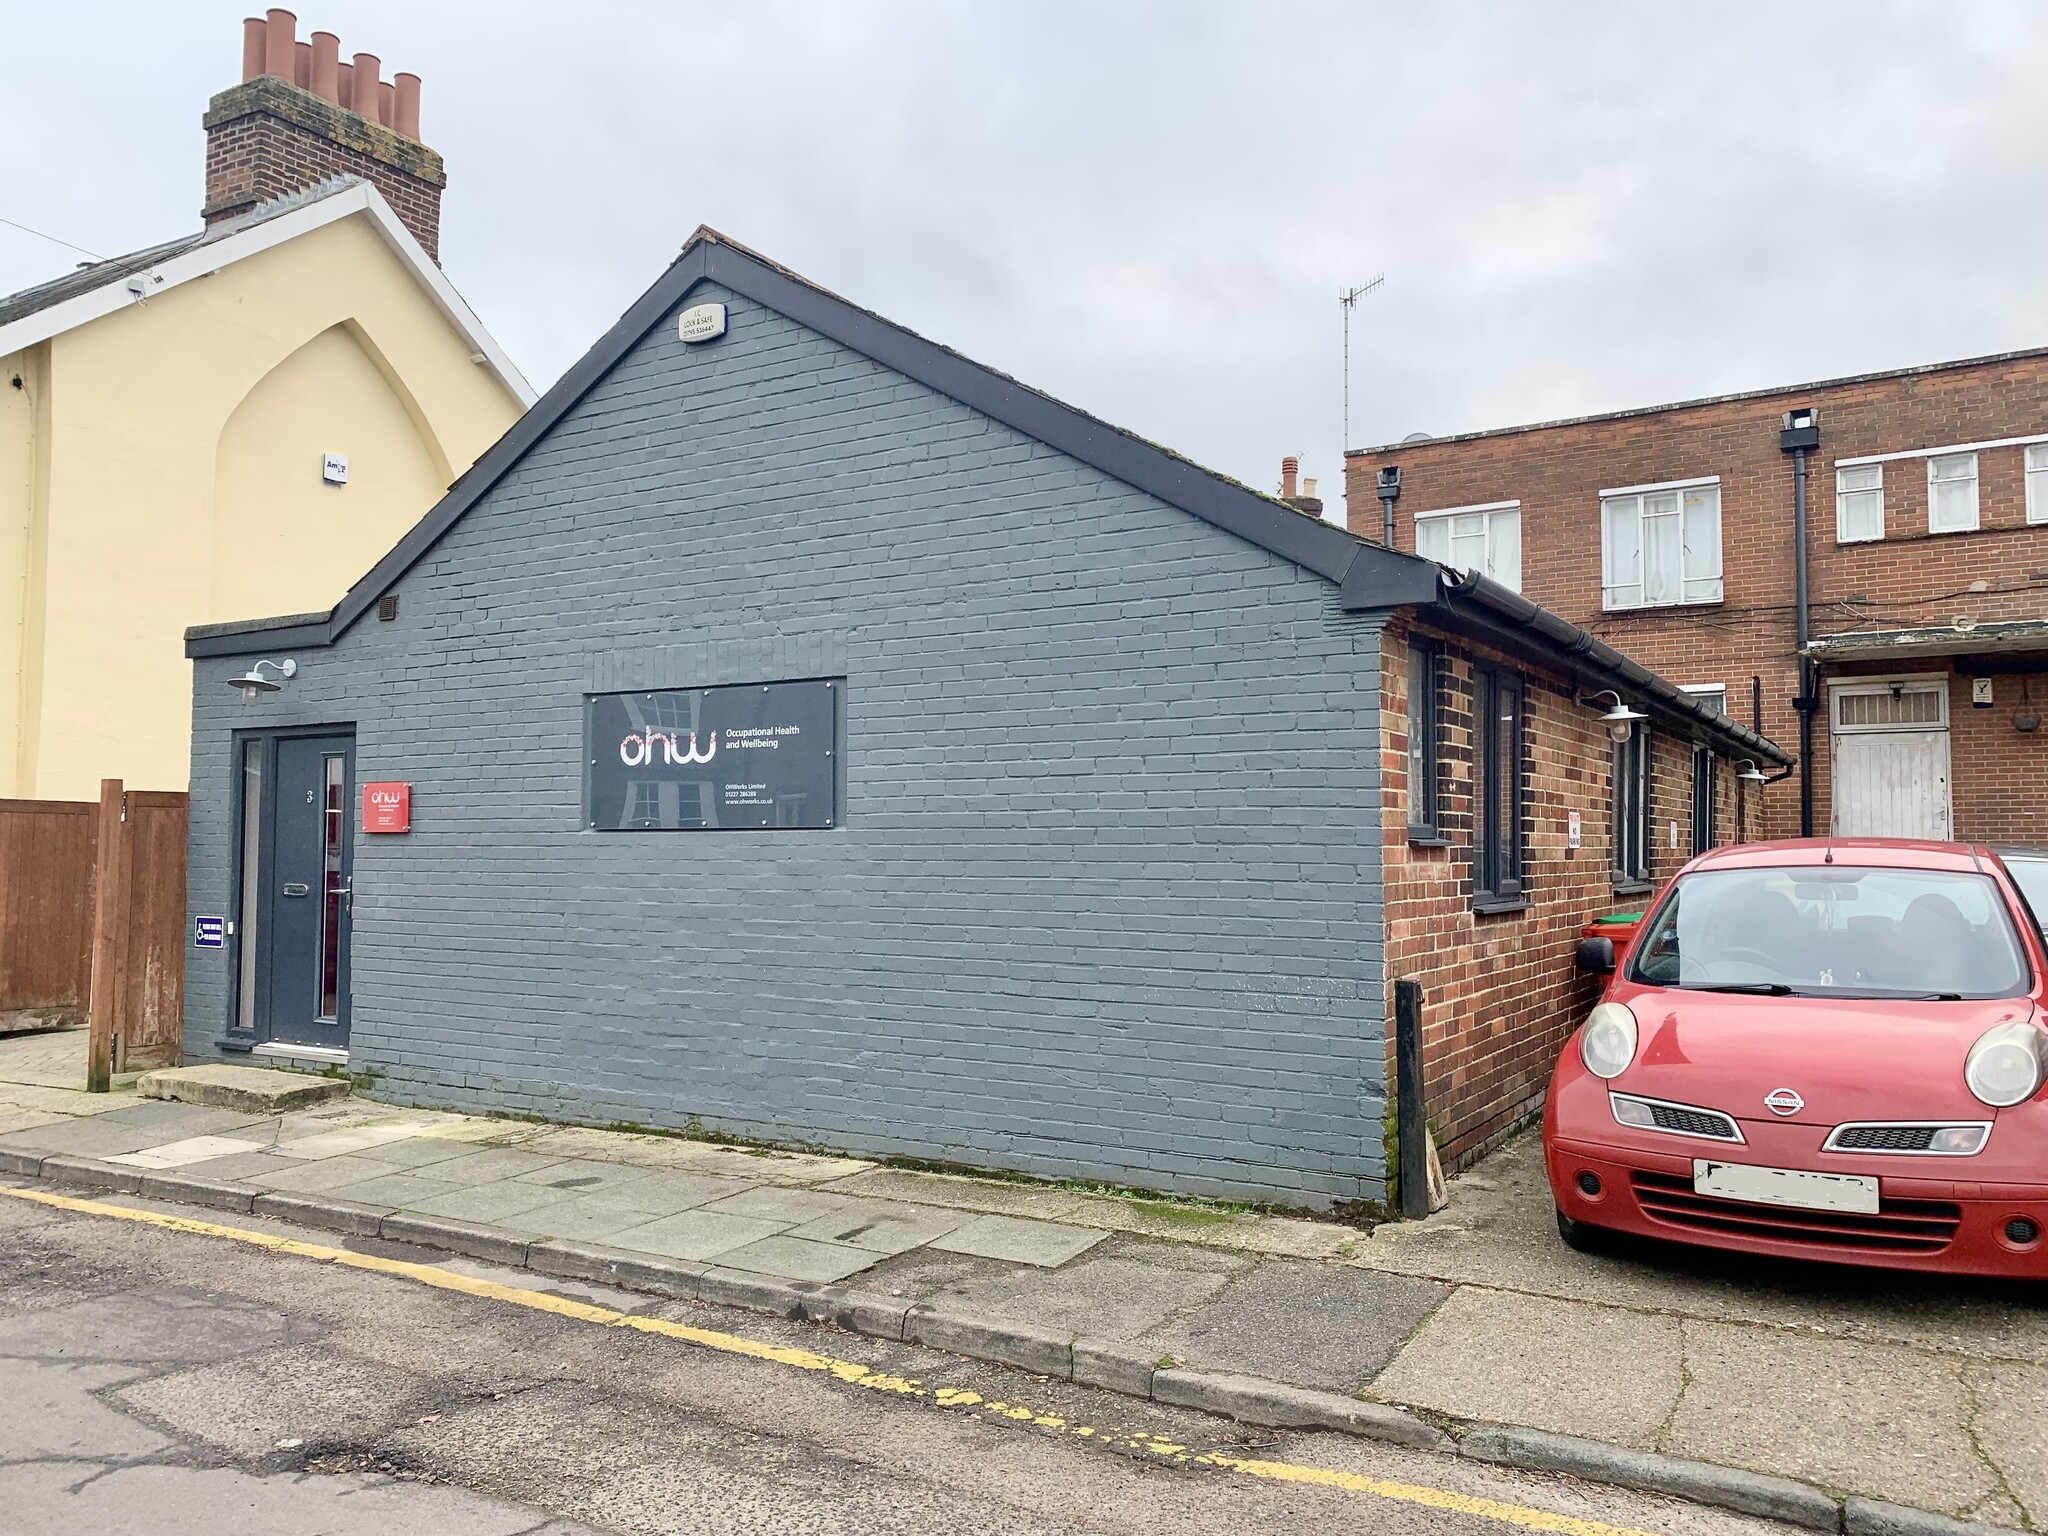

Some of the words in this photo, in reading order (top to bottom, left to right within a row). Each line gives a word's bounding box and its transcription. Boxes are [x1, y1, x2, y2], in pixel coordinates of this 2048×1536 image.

[725, 726, 774, 739] Occupational
[774, 725, 800, 735] Health
[725, 739, 740, 749] and
[741, 738, 779, 749] Wellbeing
[748, 782, 766, 790] Limited
[306, 790, 313, 803] 3
[1768, 1098, 1800, 1106] NISSAN
